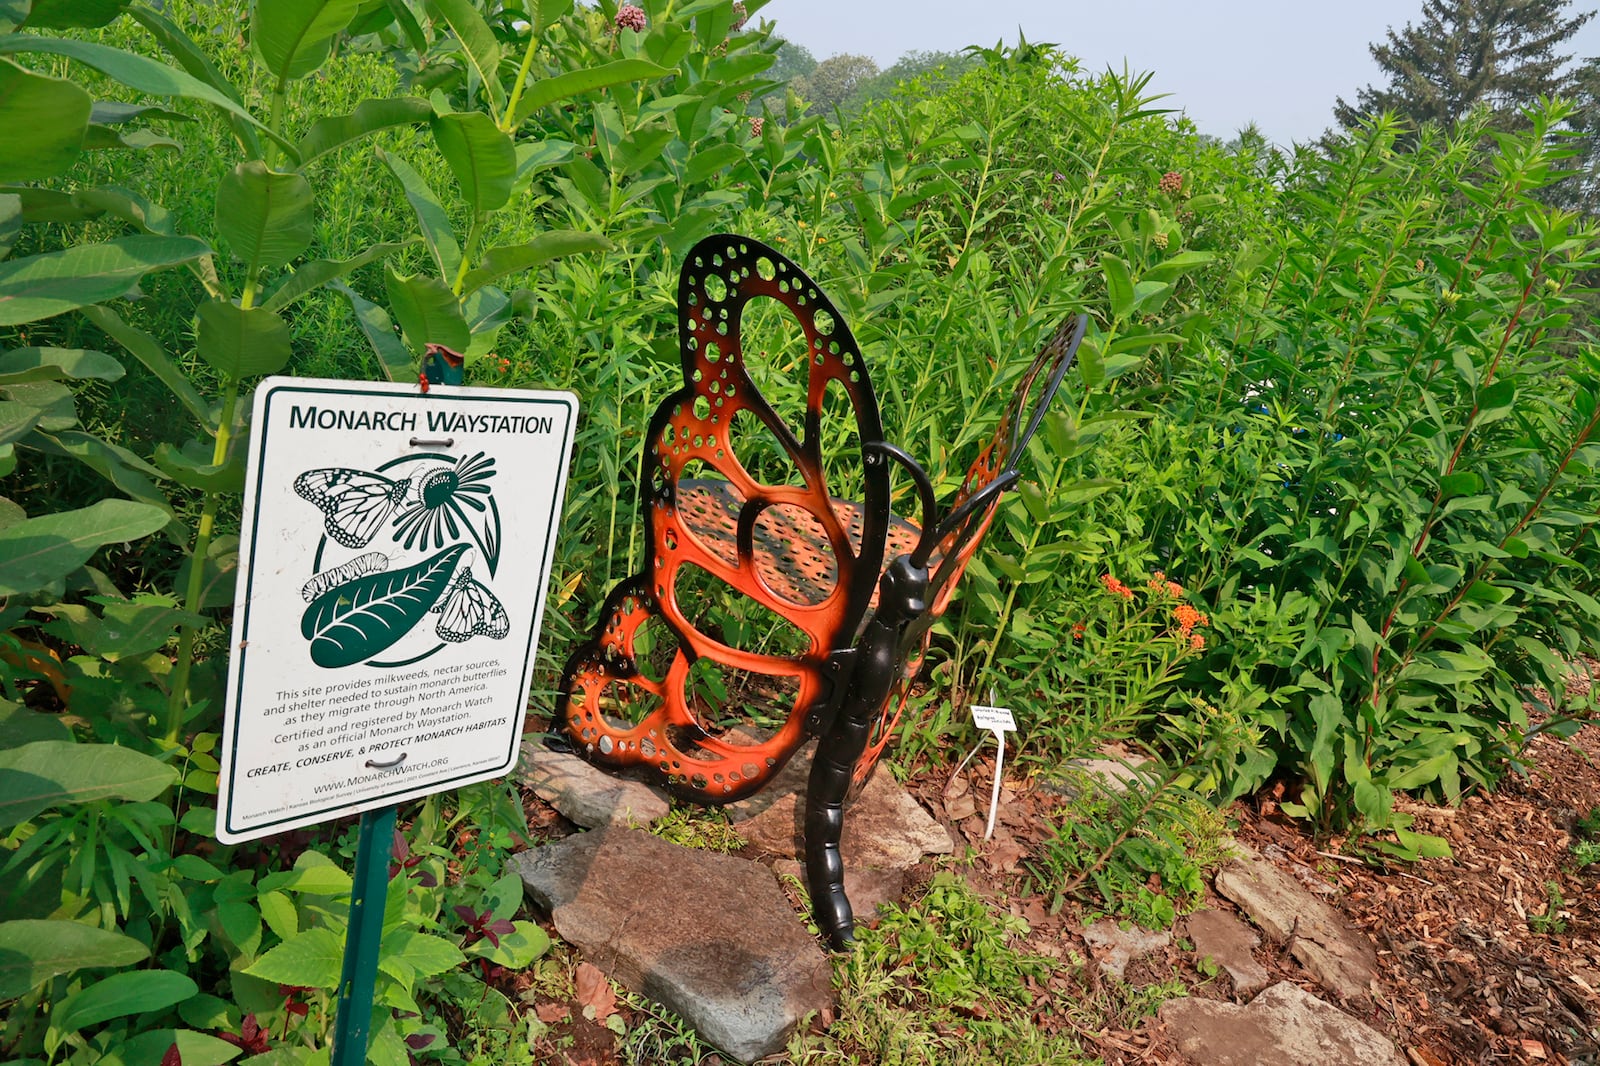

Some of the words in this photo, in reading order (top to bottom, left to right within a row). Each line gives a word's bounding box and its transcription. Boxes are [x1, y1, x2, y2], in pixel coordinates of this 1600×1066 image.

[264, 705, 285, 716] and
[288, 698, 326, 712] shelter
[329, 691, 368, 705] needed
[384, 683, 417, 695] sustain
[420, 676, 460, 689] monarch
[463, 668, 507, 682] butterflies
[276, 691, 298, 701] This
[302, 687, 322, 697] site
[325, 679, 371, 695] provides
[375, 669, 429, 685] milkweeds,
[433, 665, 463, 675] nectar
[466, 659, 500, 670] sources,
[275, 726, 324, 744] Certified
[327, 723, 348, 733] and
[351, 712, 403, 730] registered
[406, 710, 417, 720] by
[420, 702, 462, 716] Monarch
[465, 696, 493, 707] Watch
[285, 717, 297, 725] as
[301, 711, 325, 722] they
[329, 704, 371, 717] migrate
[374, 695, 415, 709] through
[418, 690, 446, 701] North
[448, 683, 488, 696] America.
[247, 762, 292, 778] CREATE,
[296, 749, 354, 768] CONSERVE,
[358, 746, 366, 755] &
[368, 737, 413, 752] PROTECT
[414, 726, 464, 743] MONARCH
[465, 717, 507, 732] HABITATS
[298, 744, 309, 752] as
[313, 740, 326, 749] an
[330, 731, 366, 745] official
[370, 722, 414, 737] Monarch
[417, 712, 471, 729] Waystation.
